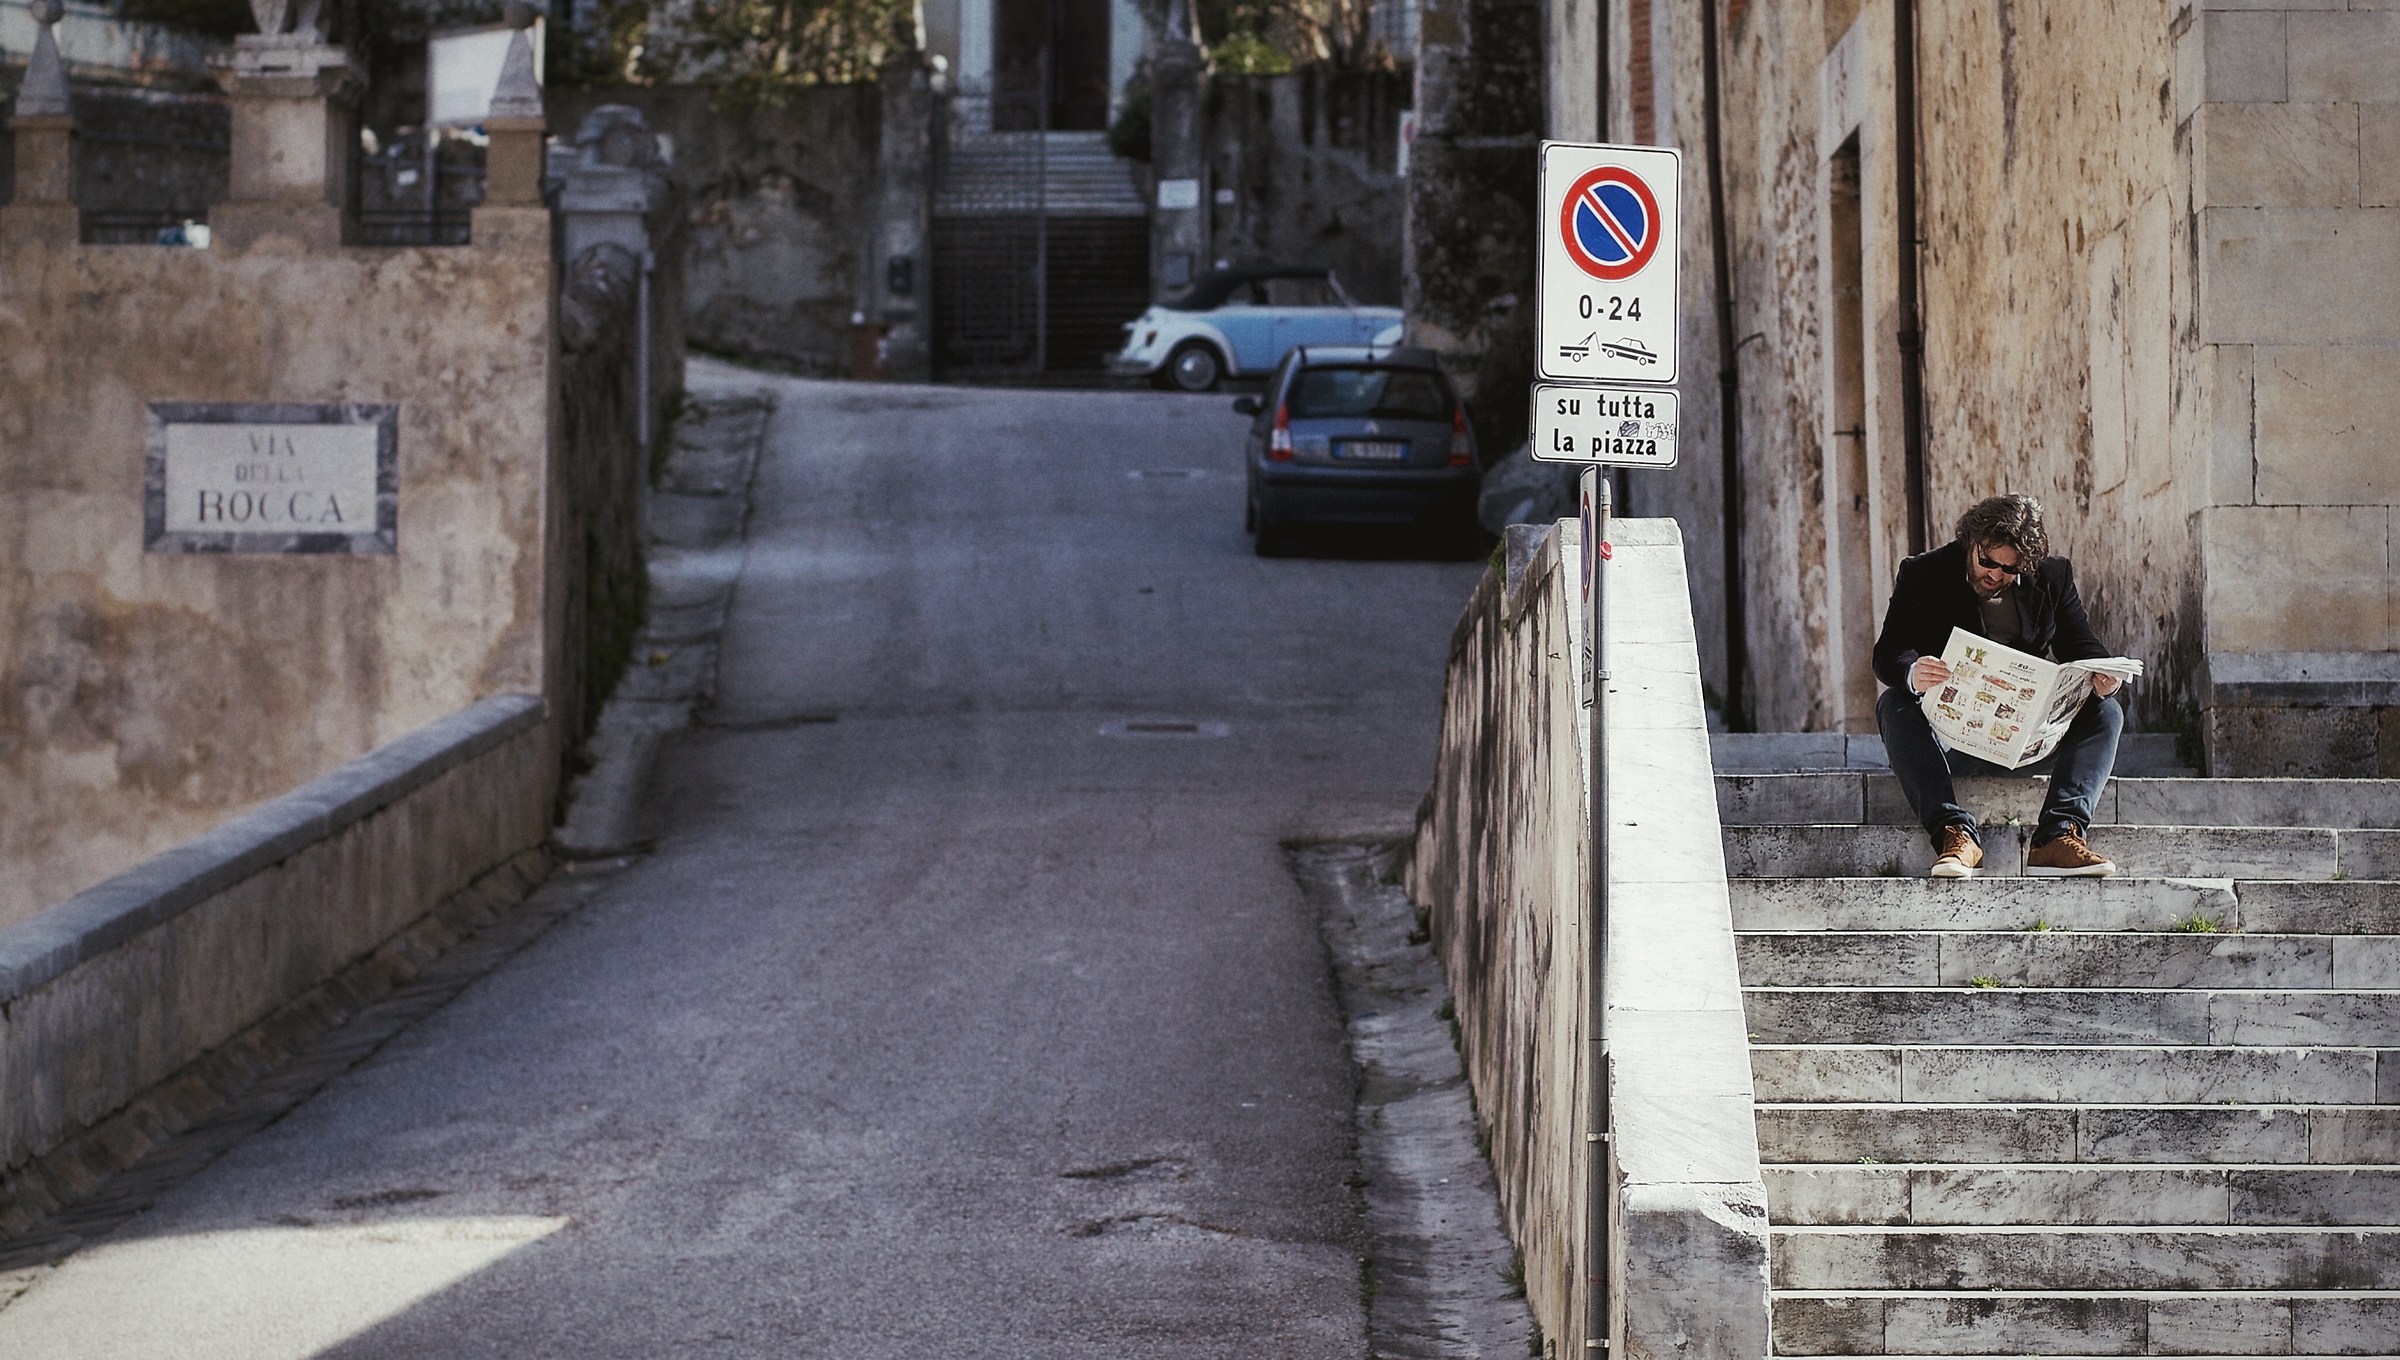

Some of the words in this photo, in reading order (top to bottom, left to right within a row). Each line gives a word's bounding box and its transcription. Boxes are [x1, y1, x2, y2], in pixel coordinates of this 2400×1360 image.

[1579, 294, 1642, 322] 0-24
[1557, 398, 1581, 416] su
[1597, 393, 1655, 419] tutta
[248, 430, 296, 457] VIA
[1553, 427, 1575, 452] la
[1591, 429, 1657, 458] piazza
[197, 489, 344, 524] ROCCA
